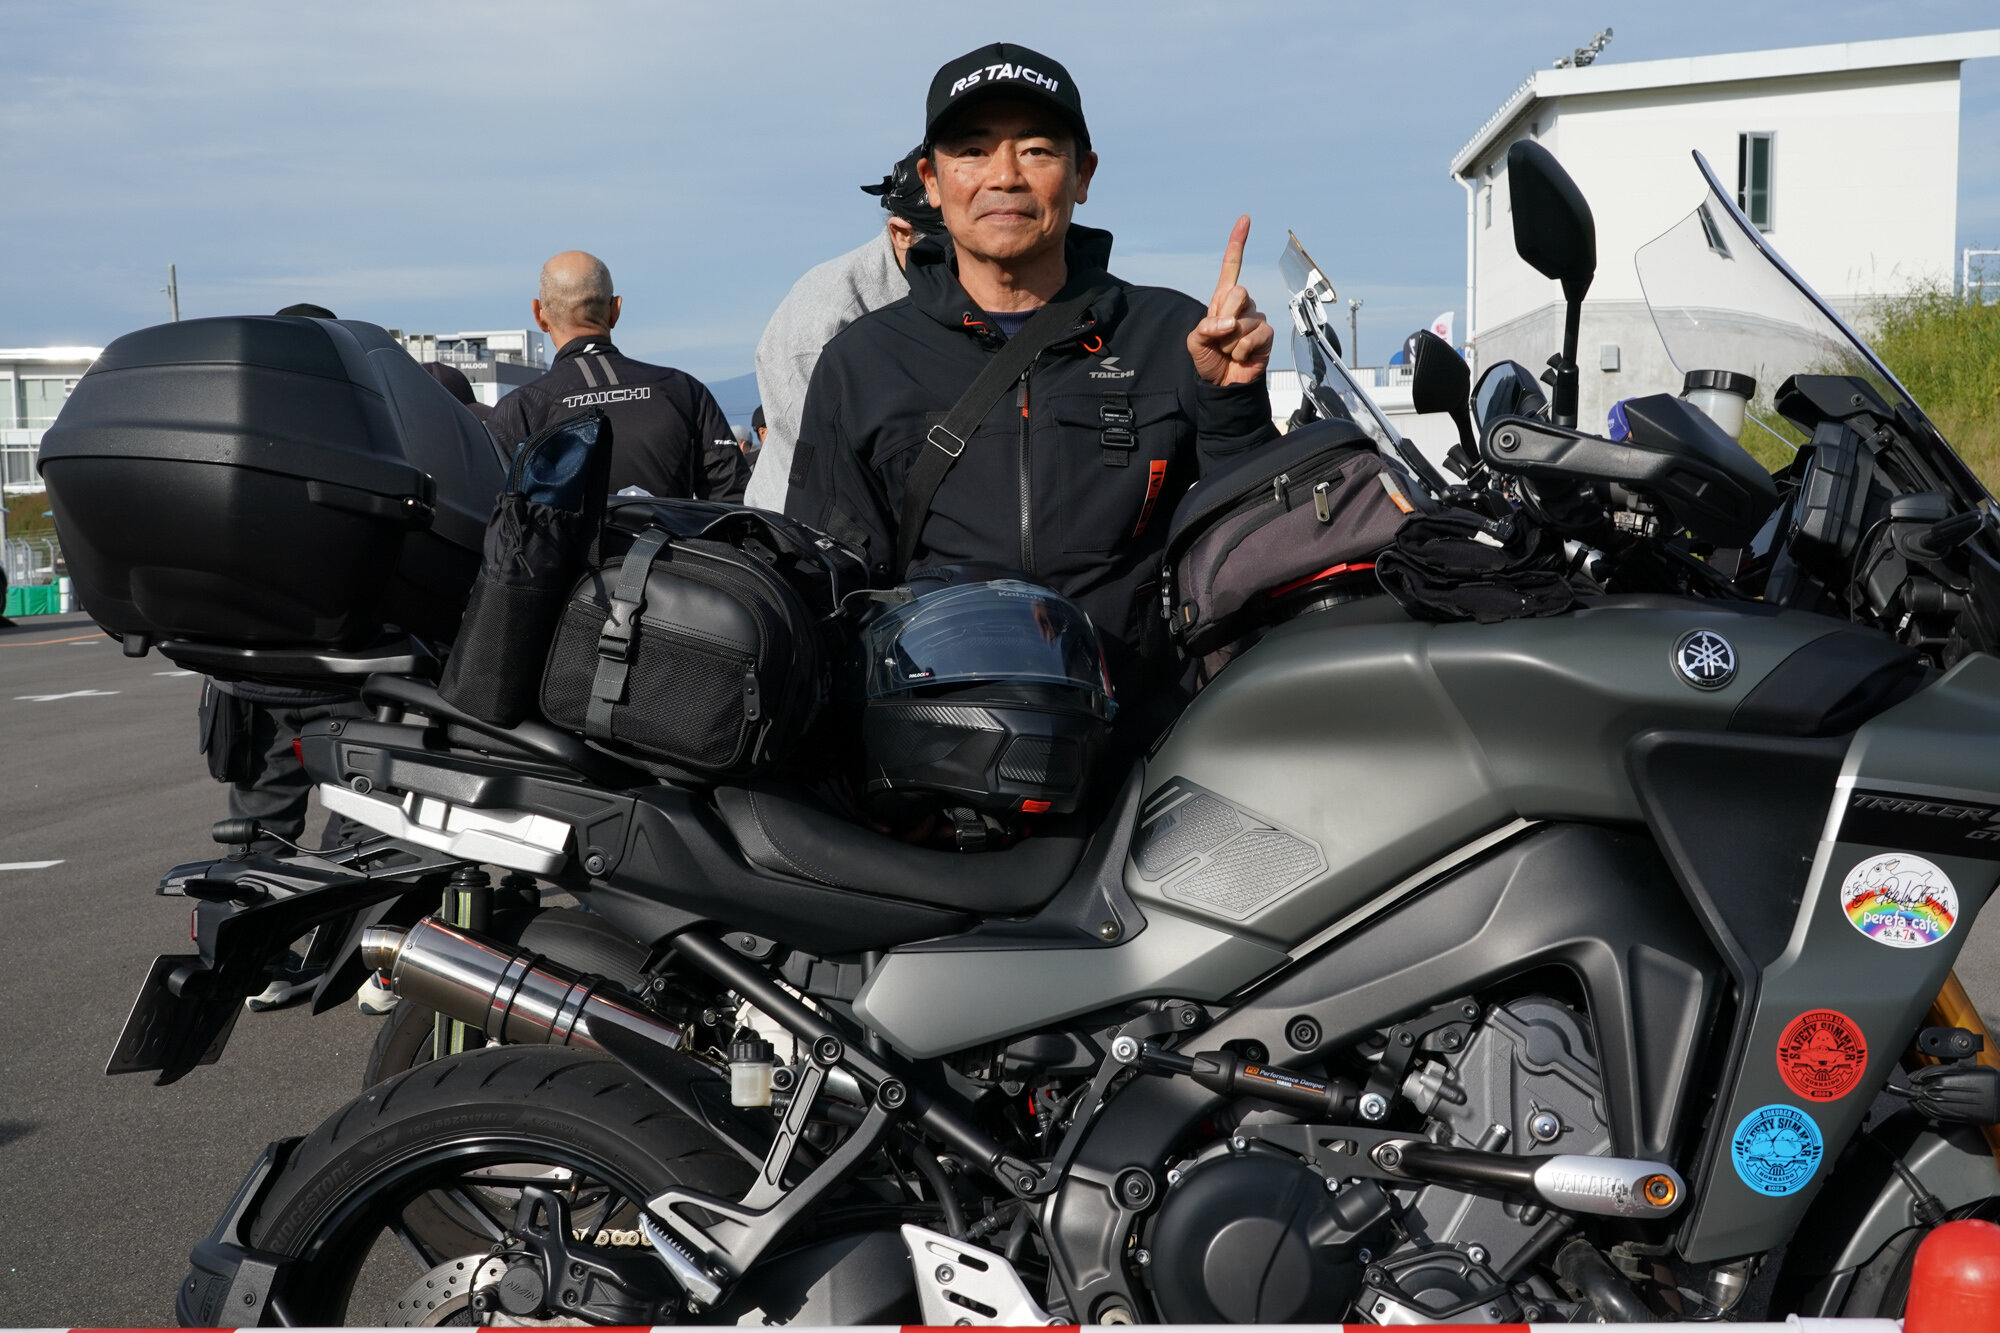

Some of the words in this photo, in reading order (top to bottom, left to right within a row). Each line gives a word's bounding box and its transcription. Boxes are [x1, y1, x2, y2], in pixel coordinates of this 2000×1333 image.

[949, 68, 983, 97] RS
[984, 62, 1059, 93] TAICHI
[460, 362, 488, 370] SALOON
[1088, 369, 1135, 379] TAICHI
[562, 386, 651, 409] TAICHI
[1852, 794, 1992, 822] TRACER
[1911, 914, 1939, 935] cafe
[1789, 1023, 1818, 1060] SAFETY
[1820, 1022, 1856, 1061] SUMMER
[1258, 1069, 1300, 1084] Performance
[1299, 1078, 1326, 1090] Damper
[1551, 1171, 1625, 1197] YAMAHA
[1758, 1172, 1795, 1182] HOKKAIDO
[269, 1159, 355, 1252] RIDGESTONE
